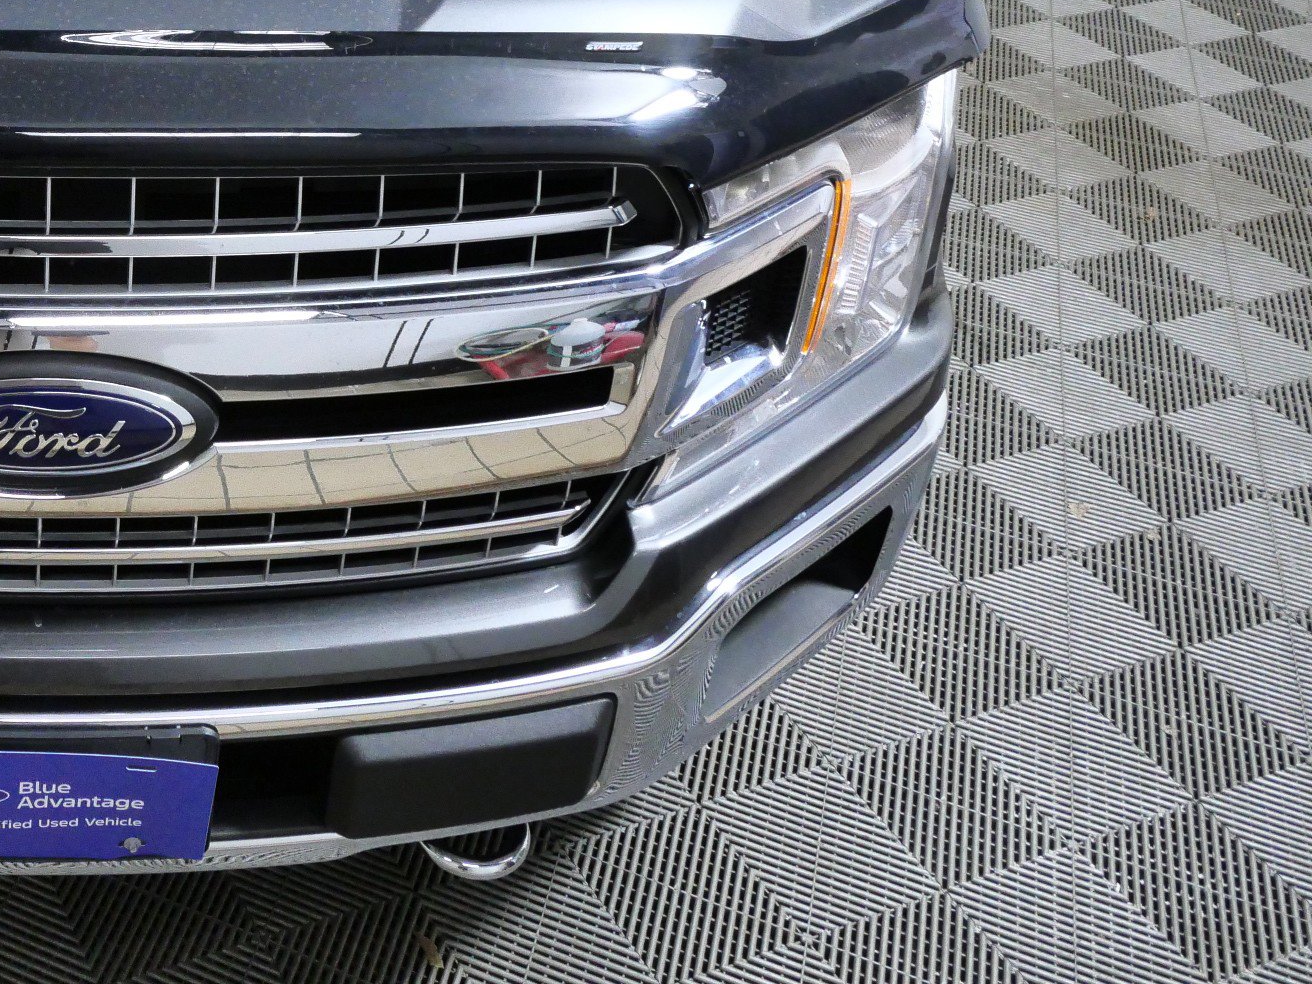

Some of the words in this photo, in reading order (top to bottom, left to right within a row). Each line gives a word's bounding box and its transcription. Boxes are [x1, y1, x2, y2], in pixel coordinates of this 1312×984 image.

[585, 41, 644, 51] STAMPEDE
[18, 781, 71, 795] Blue
[16, 795, 145, 811] Advantage
[38, 818, 79, 828] Used
[84, 817, 143, 827] Vehicle
